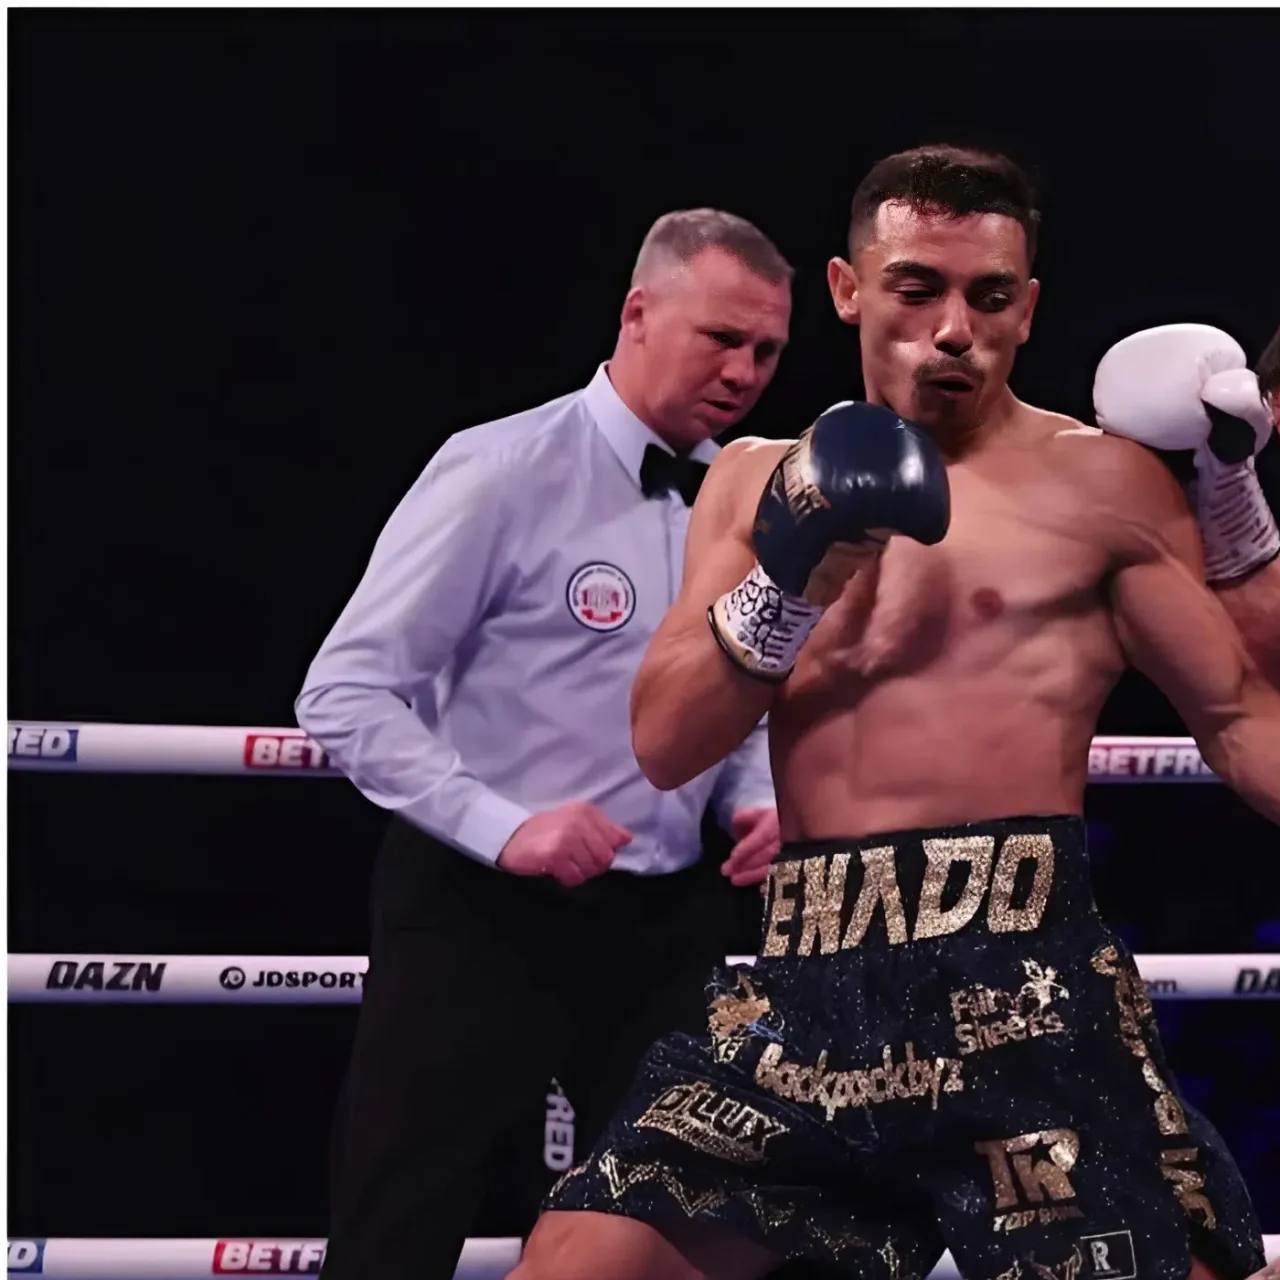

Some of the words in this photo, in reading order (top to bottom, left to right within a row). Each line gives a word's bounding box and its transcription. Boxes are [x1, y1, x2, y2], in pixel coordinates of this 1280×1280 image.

[1088, 746, 1211, 775] BETFR
[46, 960, 167, 992] DAZN
[219, 1241, 327, 1270] BETF
